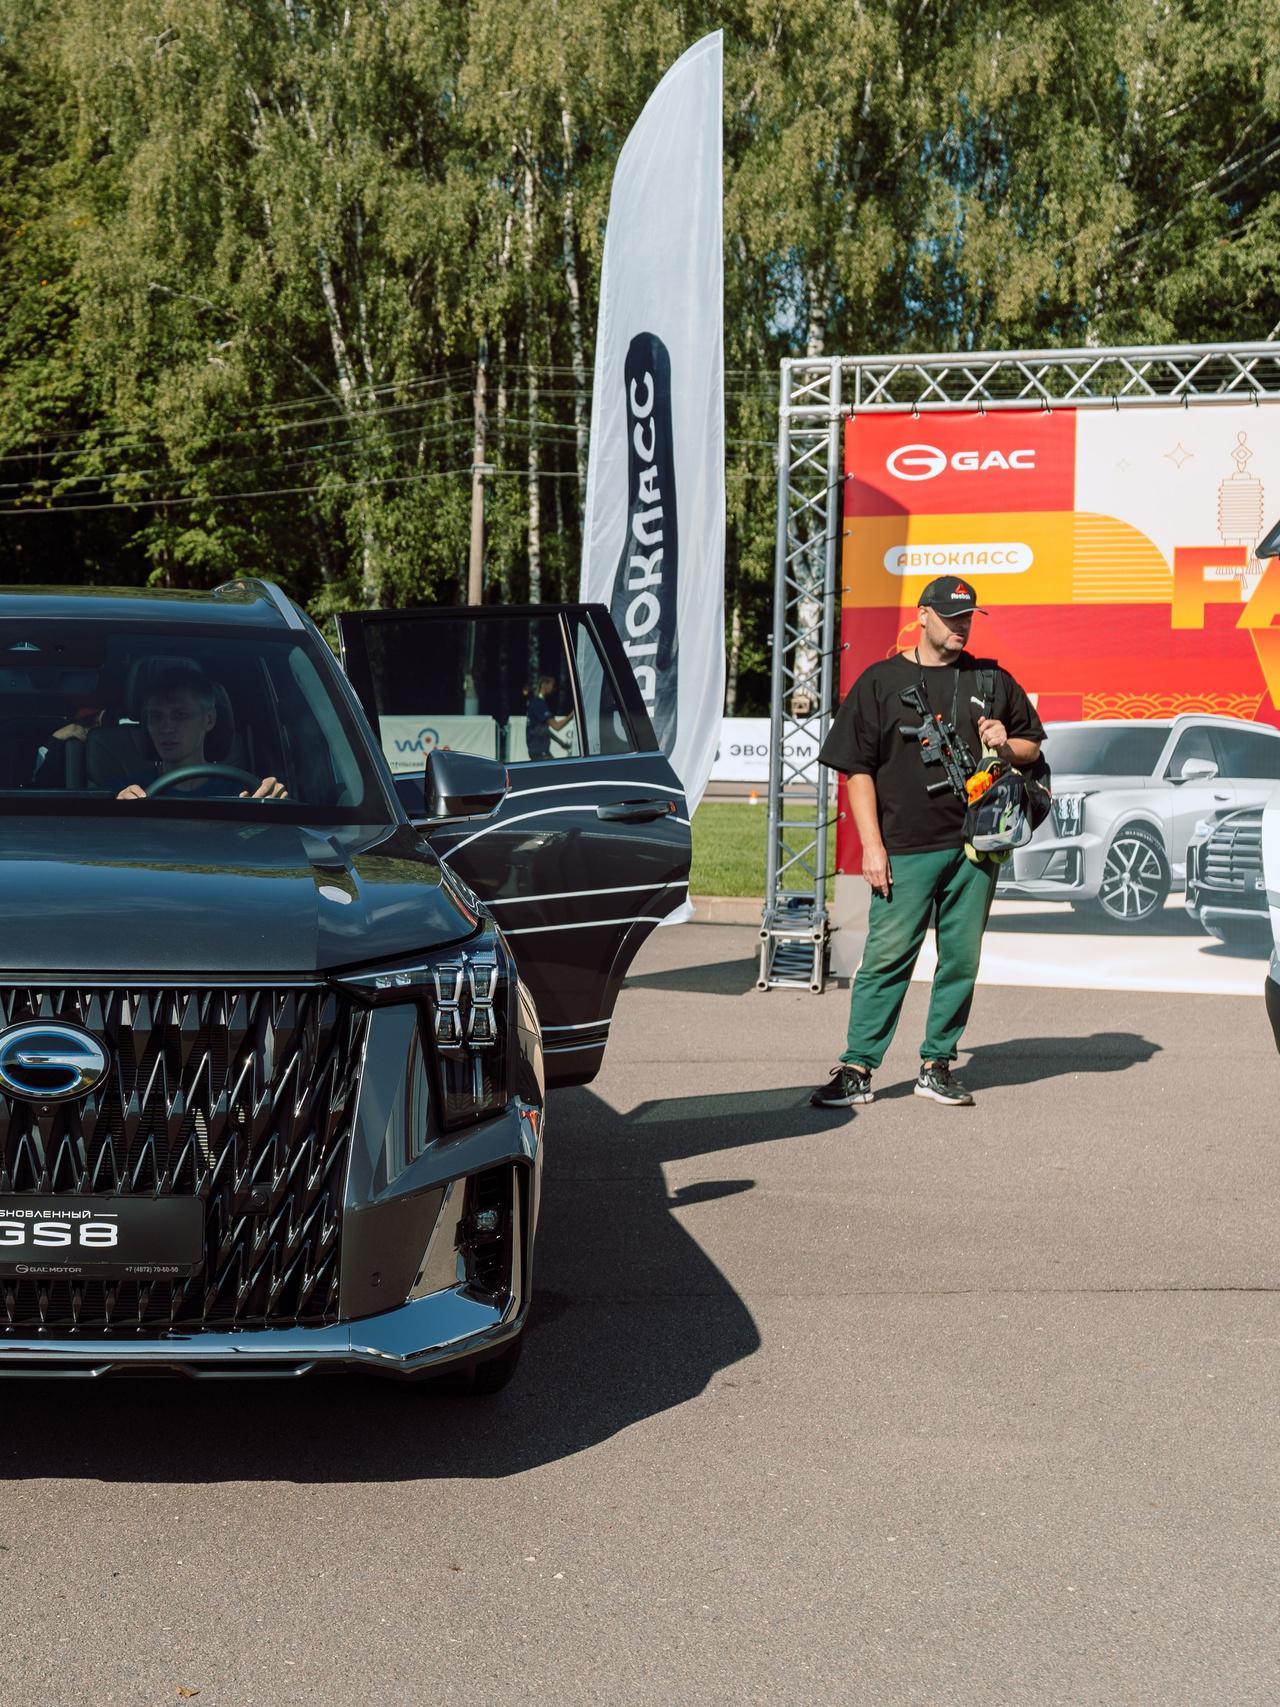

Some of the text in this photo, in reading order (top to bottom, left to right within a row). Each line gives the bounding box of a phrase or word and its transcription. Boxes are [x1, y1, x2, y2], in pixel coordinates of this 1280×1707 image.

[951, 450, 1035, 470] GAC
[897, 551, 1019, 567] АВТОКЛАСС
[730, 744, 812, 757] ЭВООМ
